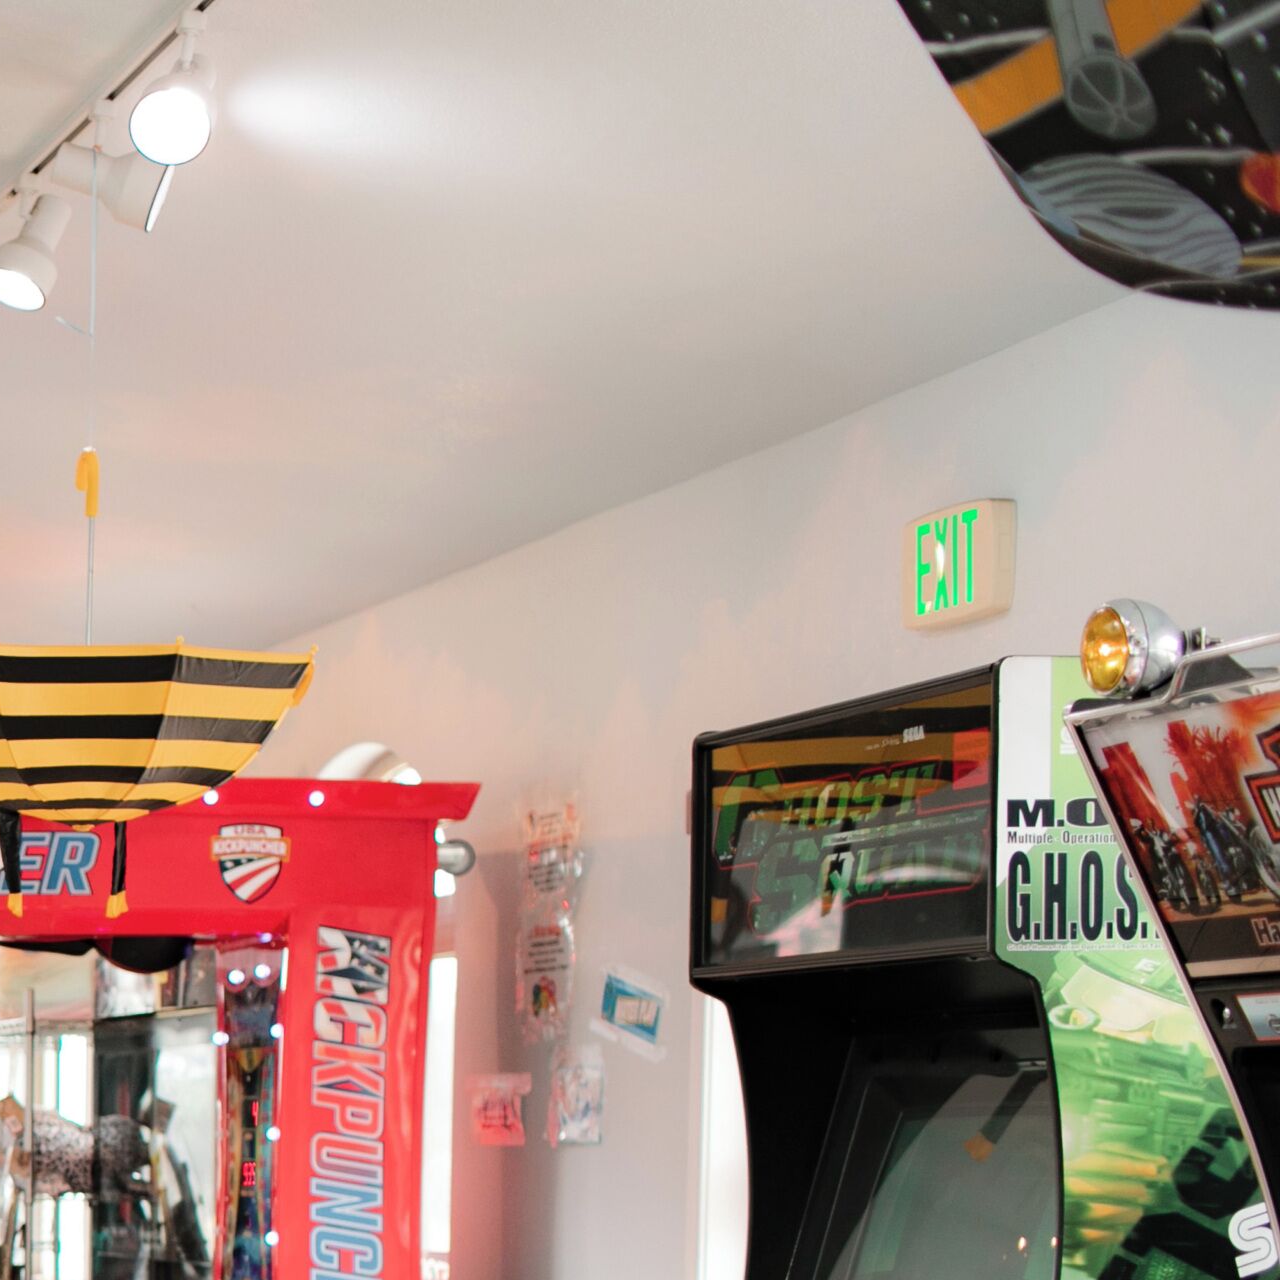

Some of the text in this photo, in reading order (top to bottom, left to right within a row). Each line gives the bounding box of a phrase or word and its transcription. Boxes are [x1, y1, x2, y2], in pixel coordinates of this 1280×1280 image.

[915, 508, 979, 616] EXIT
[1007, 831, 1054, 845] Multiple
[1007, 850, 1161, 942] G.H.O.S.
